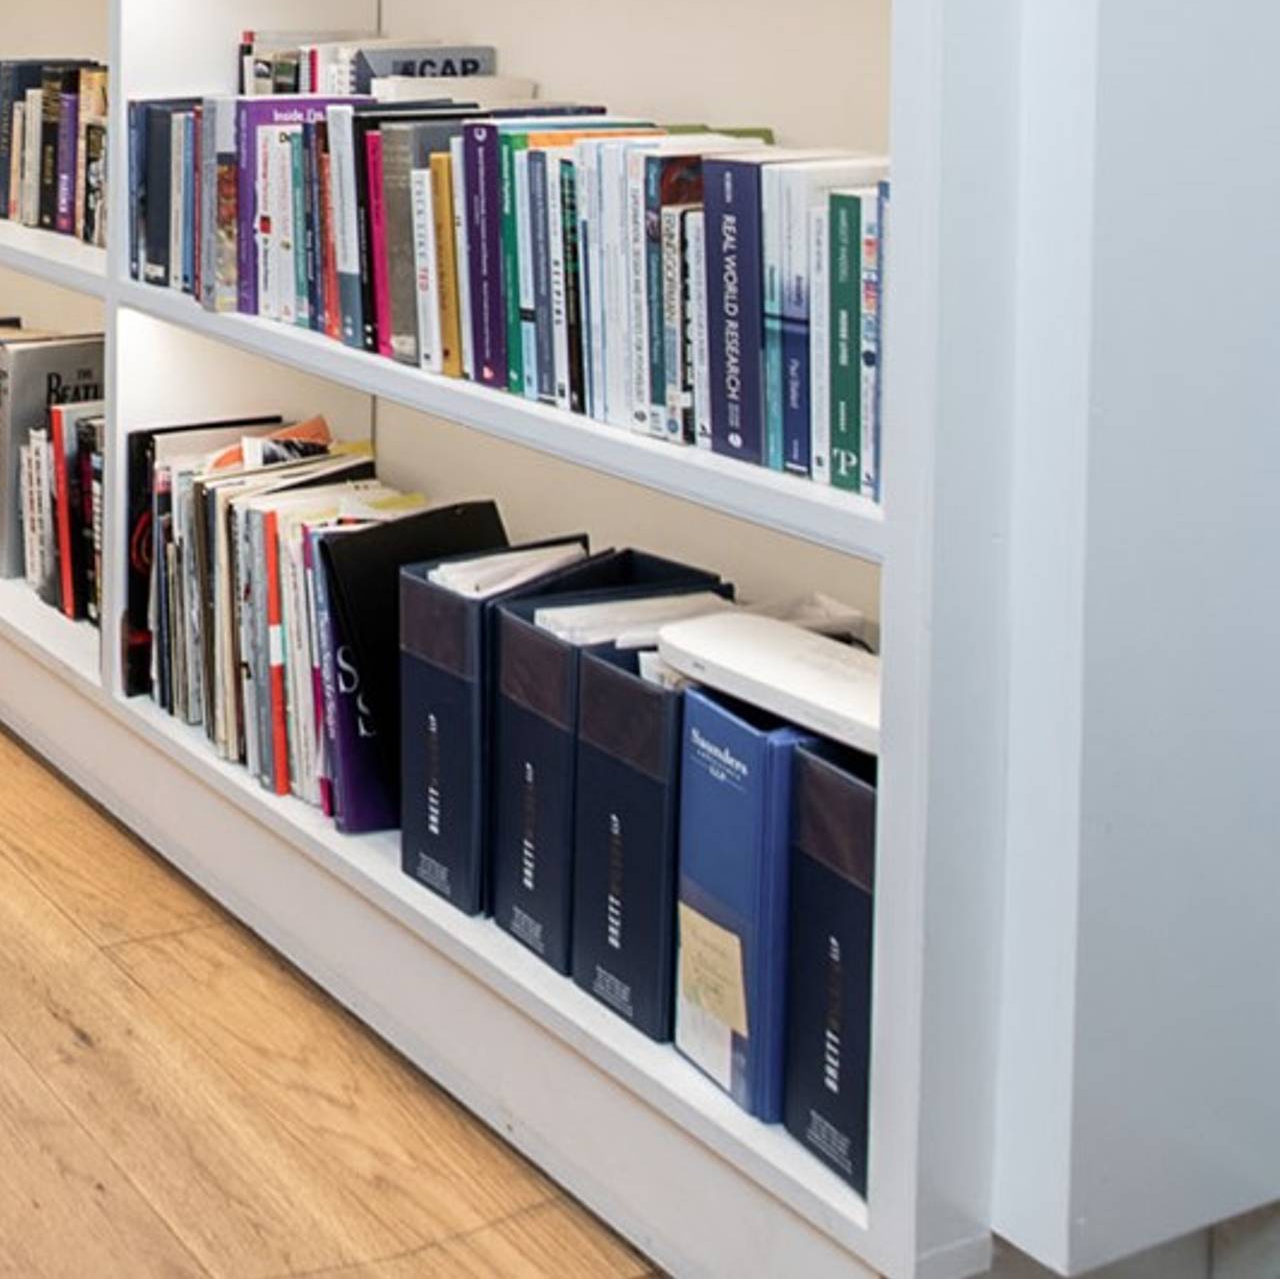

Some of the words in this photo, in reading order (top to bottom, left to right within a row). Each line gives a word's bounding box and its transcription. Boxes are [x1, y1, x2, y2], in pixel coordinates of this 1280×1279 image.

[273, 109, 305, 122] Inside
[722, 214, 740, 253] REAL
[419, 267, 429, 292] TED
[664, 259, 678, 323] GOFFMAN
[723, 255, 740, 315] WORLD
[724, 320, 741, 400] RESEARCH
[428, 714, 437, 733] LLP
[524, 762, 533, 782] LLP
[690, 727, 749, 777] Saunders
[427, 786, 439, 835] BRETT
[610, 813, 619, 834] LLP
[523, 838, 535, 890] BRETT
[607, 895, 621, 949] BRETT
[828, 935, 839, 961] LLP
[825, 1029, 840, 1094] BRETT
